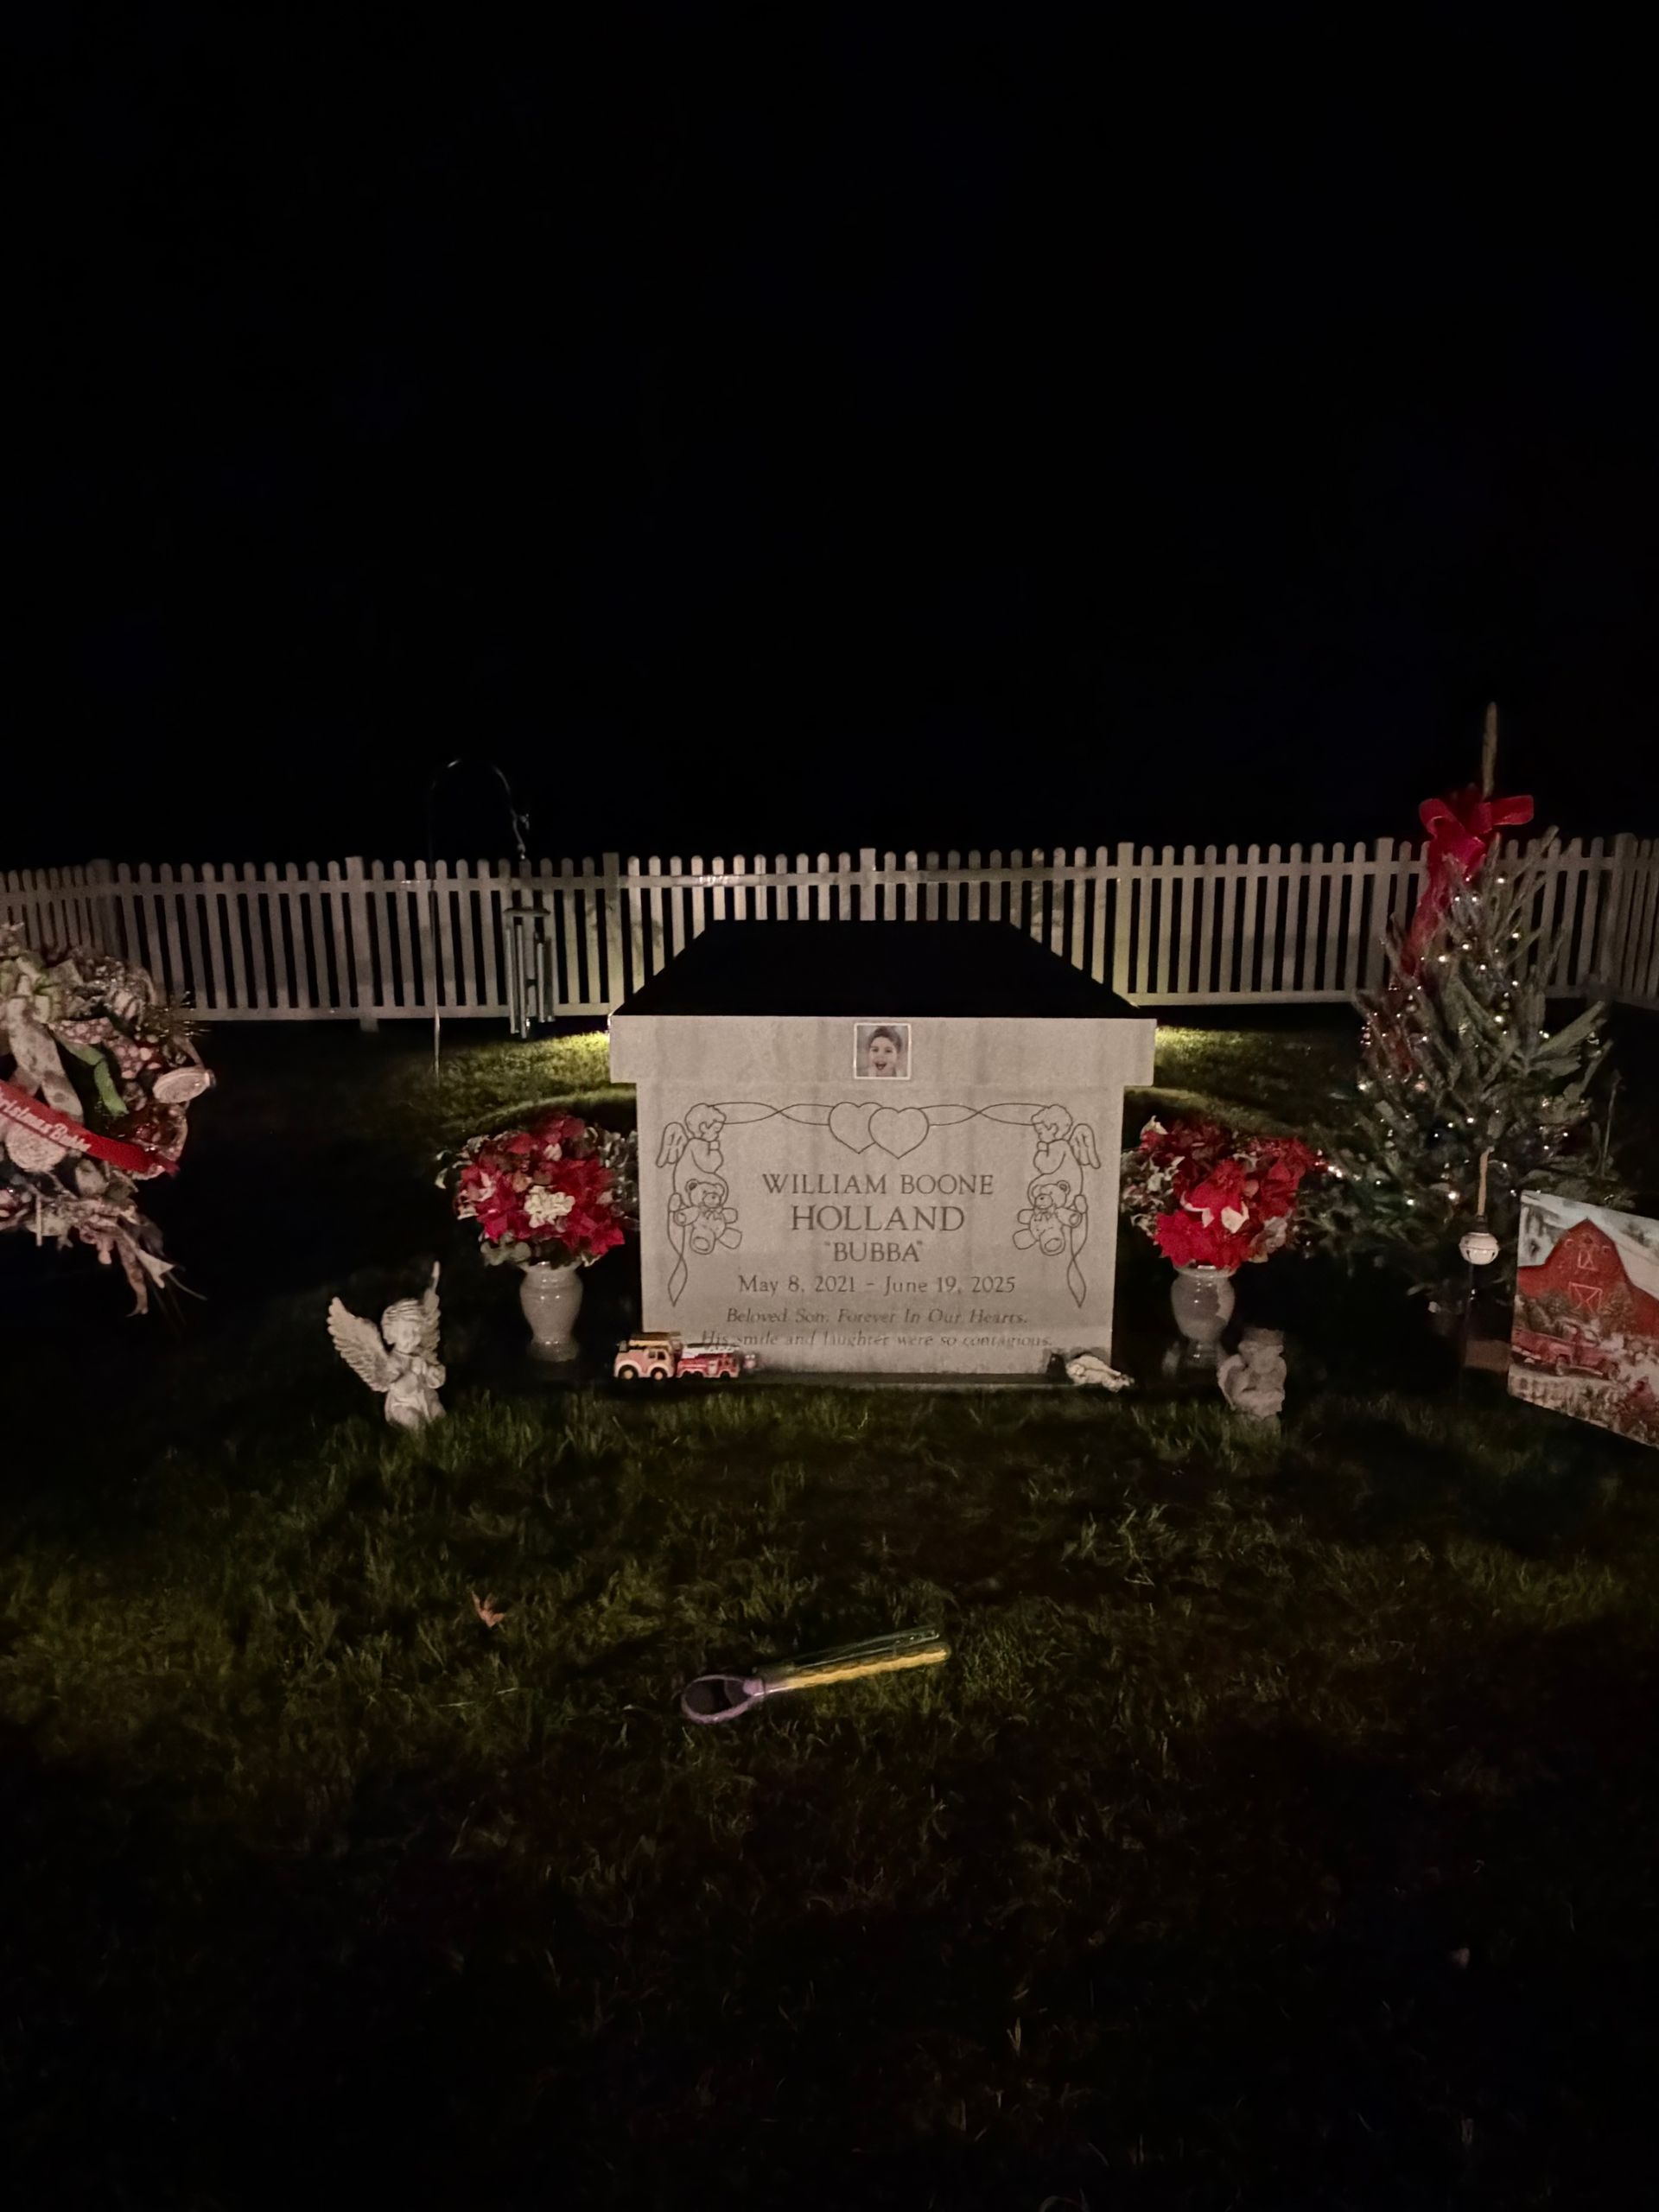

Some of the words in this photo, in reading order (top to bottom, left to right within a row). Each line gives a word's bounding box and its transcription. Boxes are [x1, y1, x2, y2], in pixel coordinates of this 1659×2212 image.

[762, 1173, 887, 1195] WILLIAM
[900, 1173, 994, 1195] BOONE
[791, 1205, 965, 1231] HOLLAND
[824, 1241, 924, 1262] "BUBBA"
[738, 1274, 778, 1297] May
[788, 1275, 804, 1294] 8,
[815, 1274, 855, 1294] 2021
[884, 1274, 928, 1296] June
[937, 1274, 962, 1295] 19,
[970, 1274, 1016, 1294] 2025
[727, 1306, 787, 1324] Beloved
[837, 1308, 896, 1324] Forever
[904, 1308, 920, 1324] In
[927, 1308, 962, 1324] Our
[969, 1308, 1028, 1325] Hearts.
[702, 1331, 728, 1345] His
[786, 1331, 817, 1345] and
[897, 1336, 934, 1346] were
[940, 1336, 957, 1346] so
